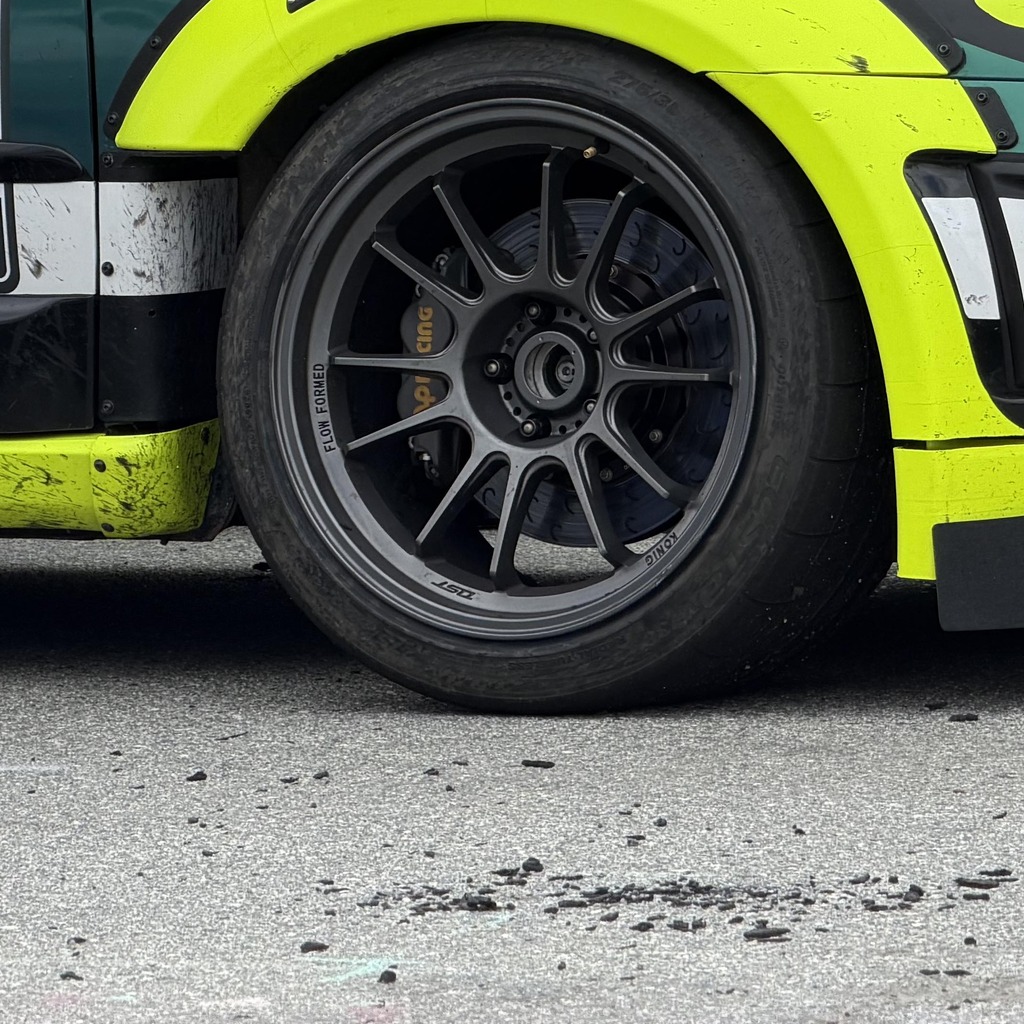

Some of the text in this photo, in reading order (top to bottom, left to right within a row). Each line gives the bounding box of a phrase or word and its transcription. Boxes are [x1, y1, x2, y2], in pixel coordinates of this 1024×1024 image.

[312, 363, 337, 453] FLOW FORMED
[644, 531, 679, 567] KONIG
